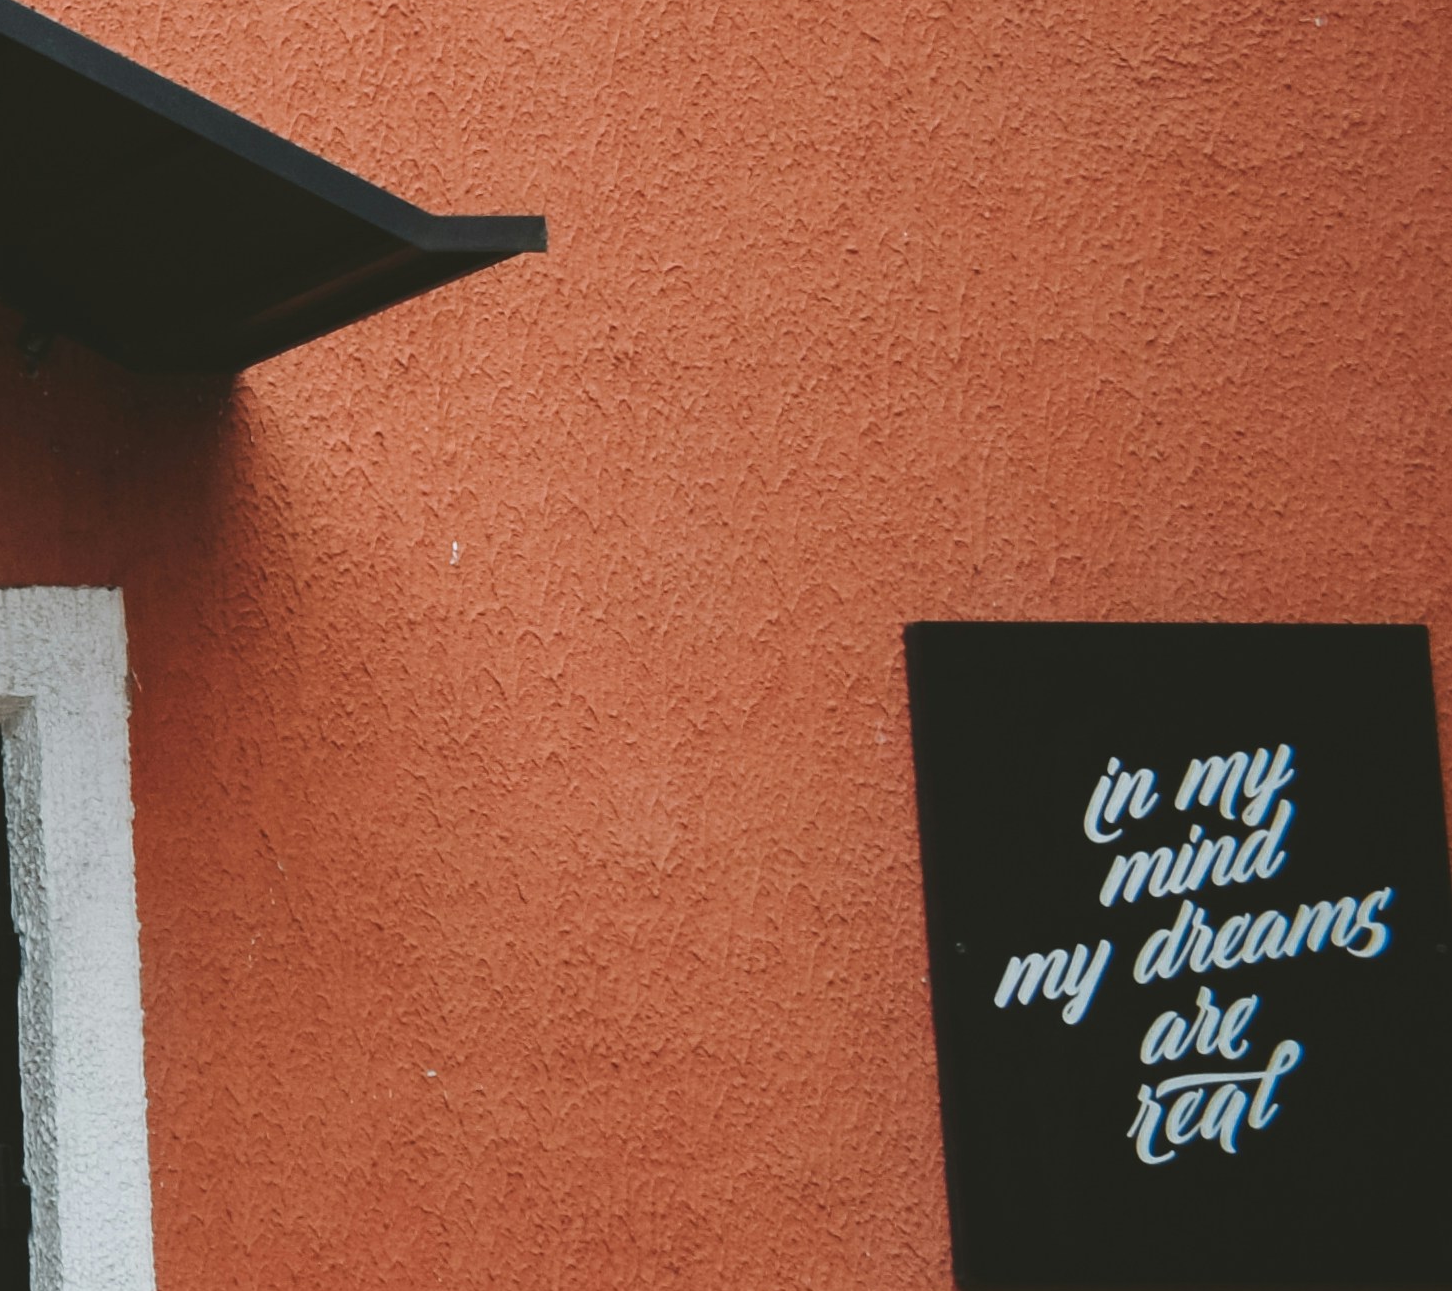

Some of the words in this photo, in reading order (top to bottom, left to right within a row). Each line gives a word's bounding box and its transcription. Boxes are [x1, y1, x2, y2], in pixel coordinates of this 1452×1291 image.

[1084, 756, 1159, 844] in
[1174, 743, 1295, 827] my
[1099, 799, 1295, 907] mind
[994, 939, 1112, 1025] my
[1133, 887, 1392, 984] dreams
[1140, 986, 1258, 1065] are
[1127, 1040, 1302, 1165] real
